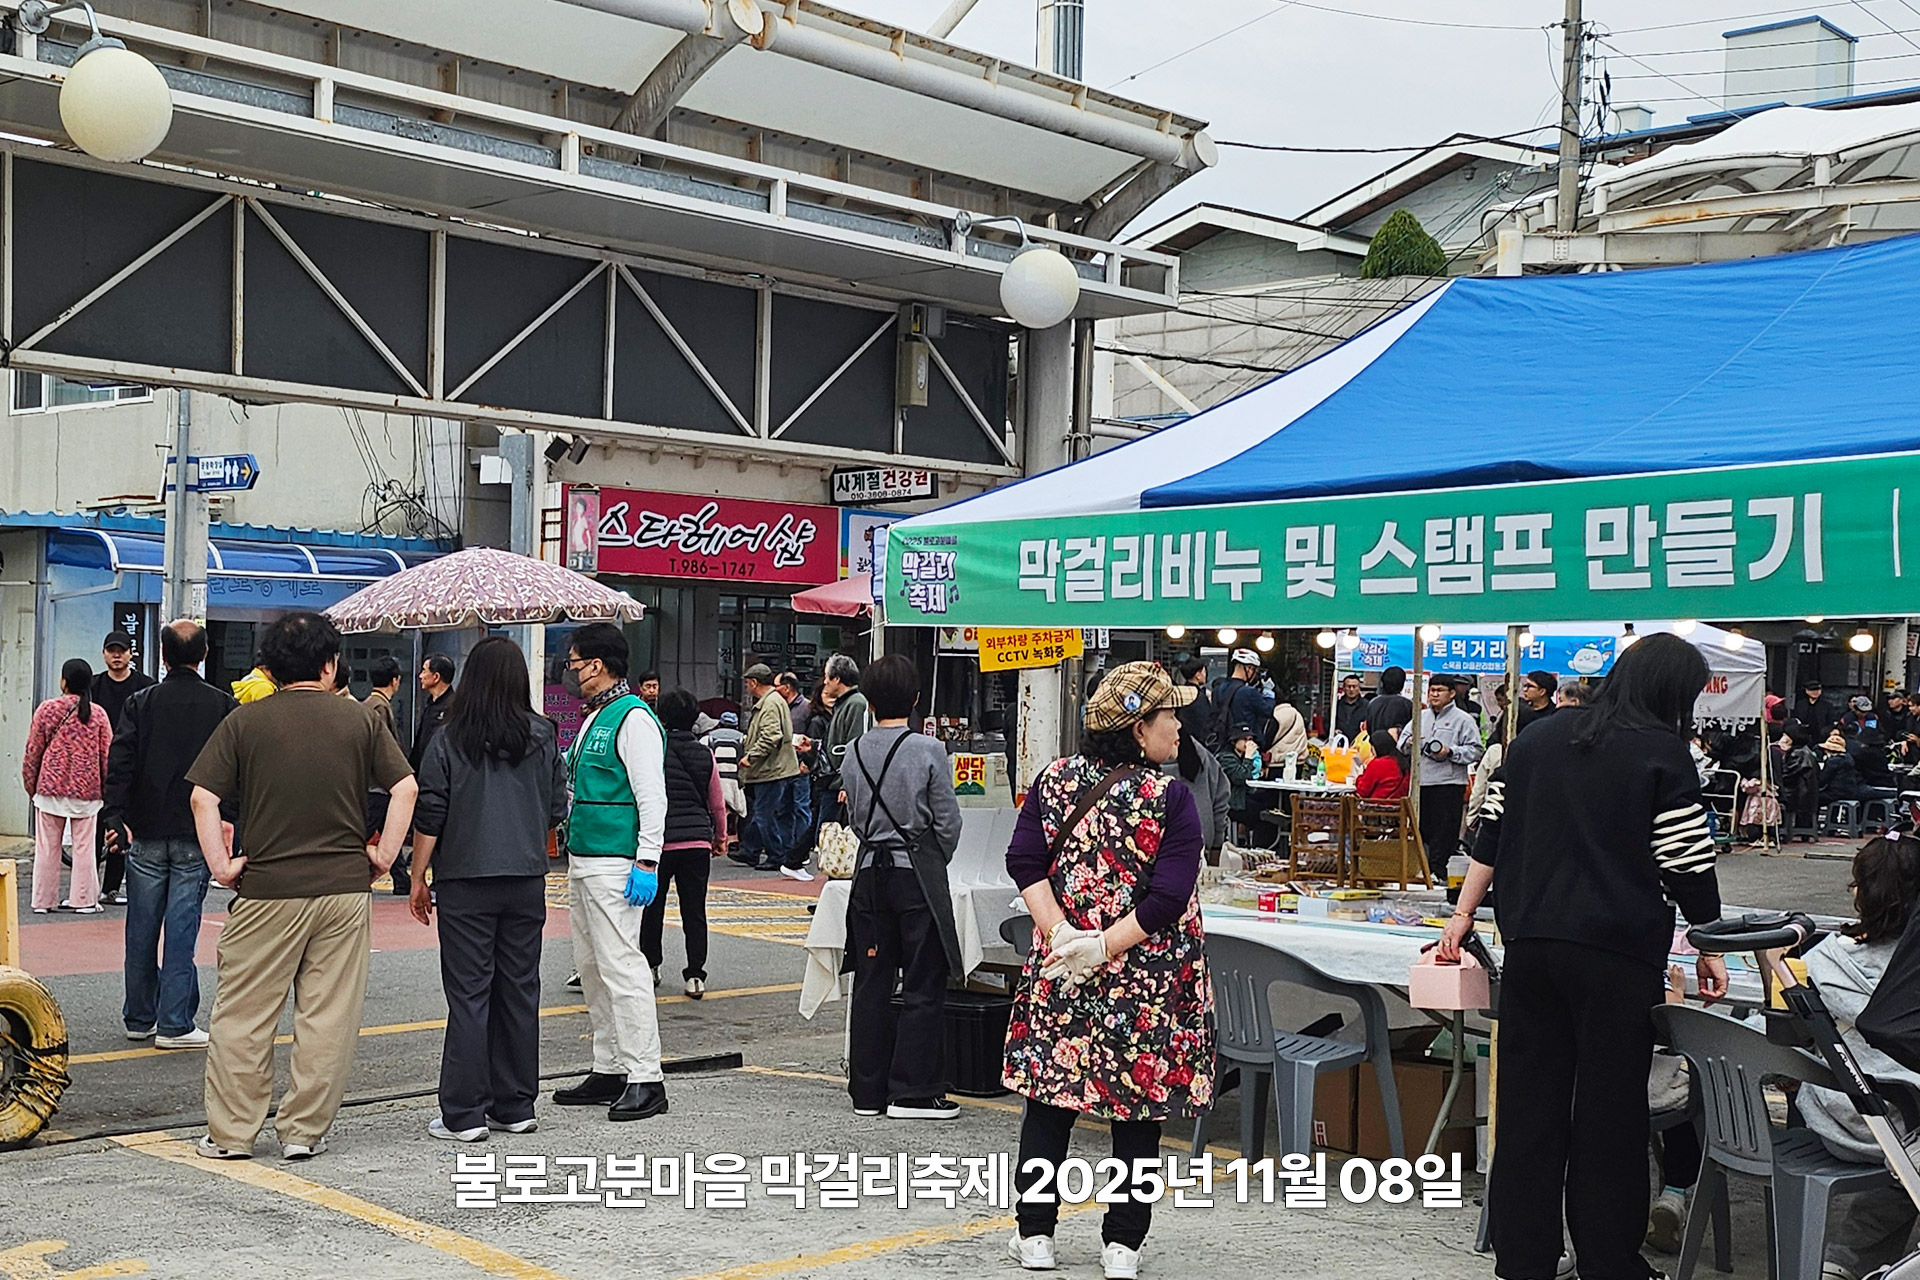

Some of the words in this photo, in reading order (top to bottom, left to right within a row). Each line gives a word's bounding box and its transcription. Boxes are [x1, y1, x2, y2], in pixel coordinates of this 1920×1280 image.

[836, 469, 928, 493] 사계절건강원
[1018, 530, 1262, 602] 막걸리비누
[1285, 523, 1336, 599] 및
[1360, 513, 1556, 595] 스탬프
[1585, 492, 1823, 590] 만들기
[669, 558, 755, 577] T.986-1747
[902, 550, 957, 580] 막걸리
[908, 582, 947, 613] 축제
[985, 633, 1028, 650] 외부차량
[1031, 628, 1075, 646] 주차금지
[997, 649, 1029, 663] CCTV
[1032, 645, 1065, 660] 녹화중
[955, 756, 986, 781] 생닭
